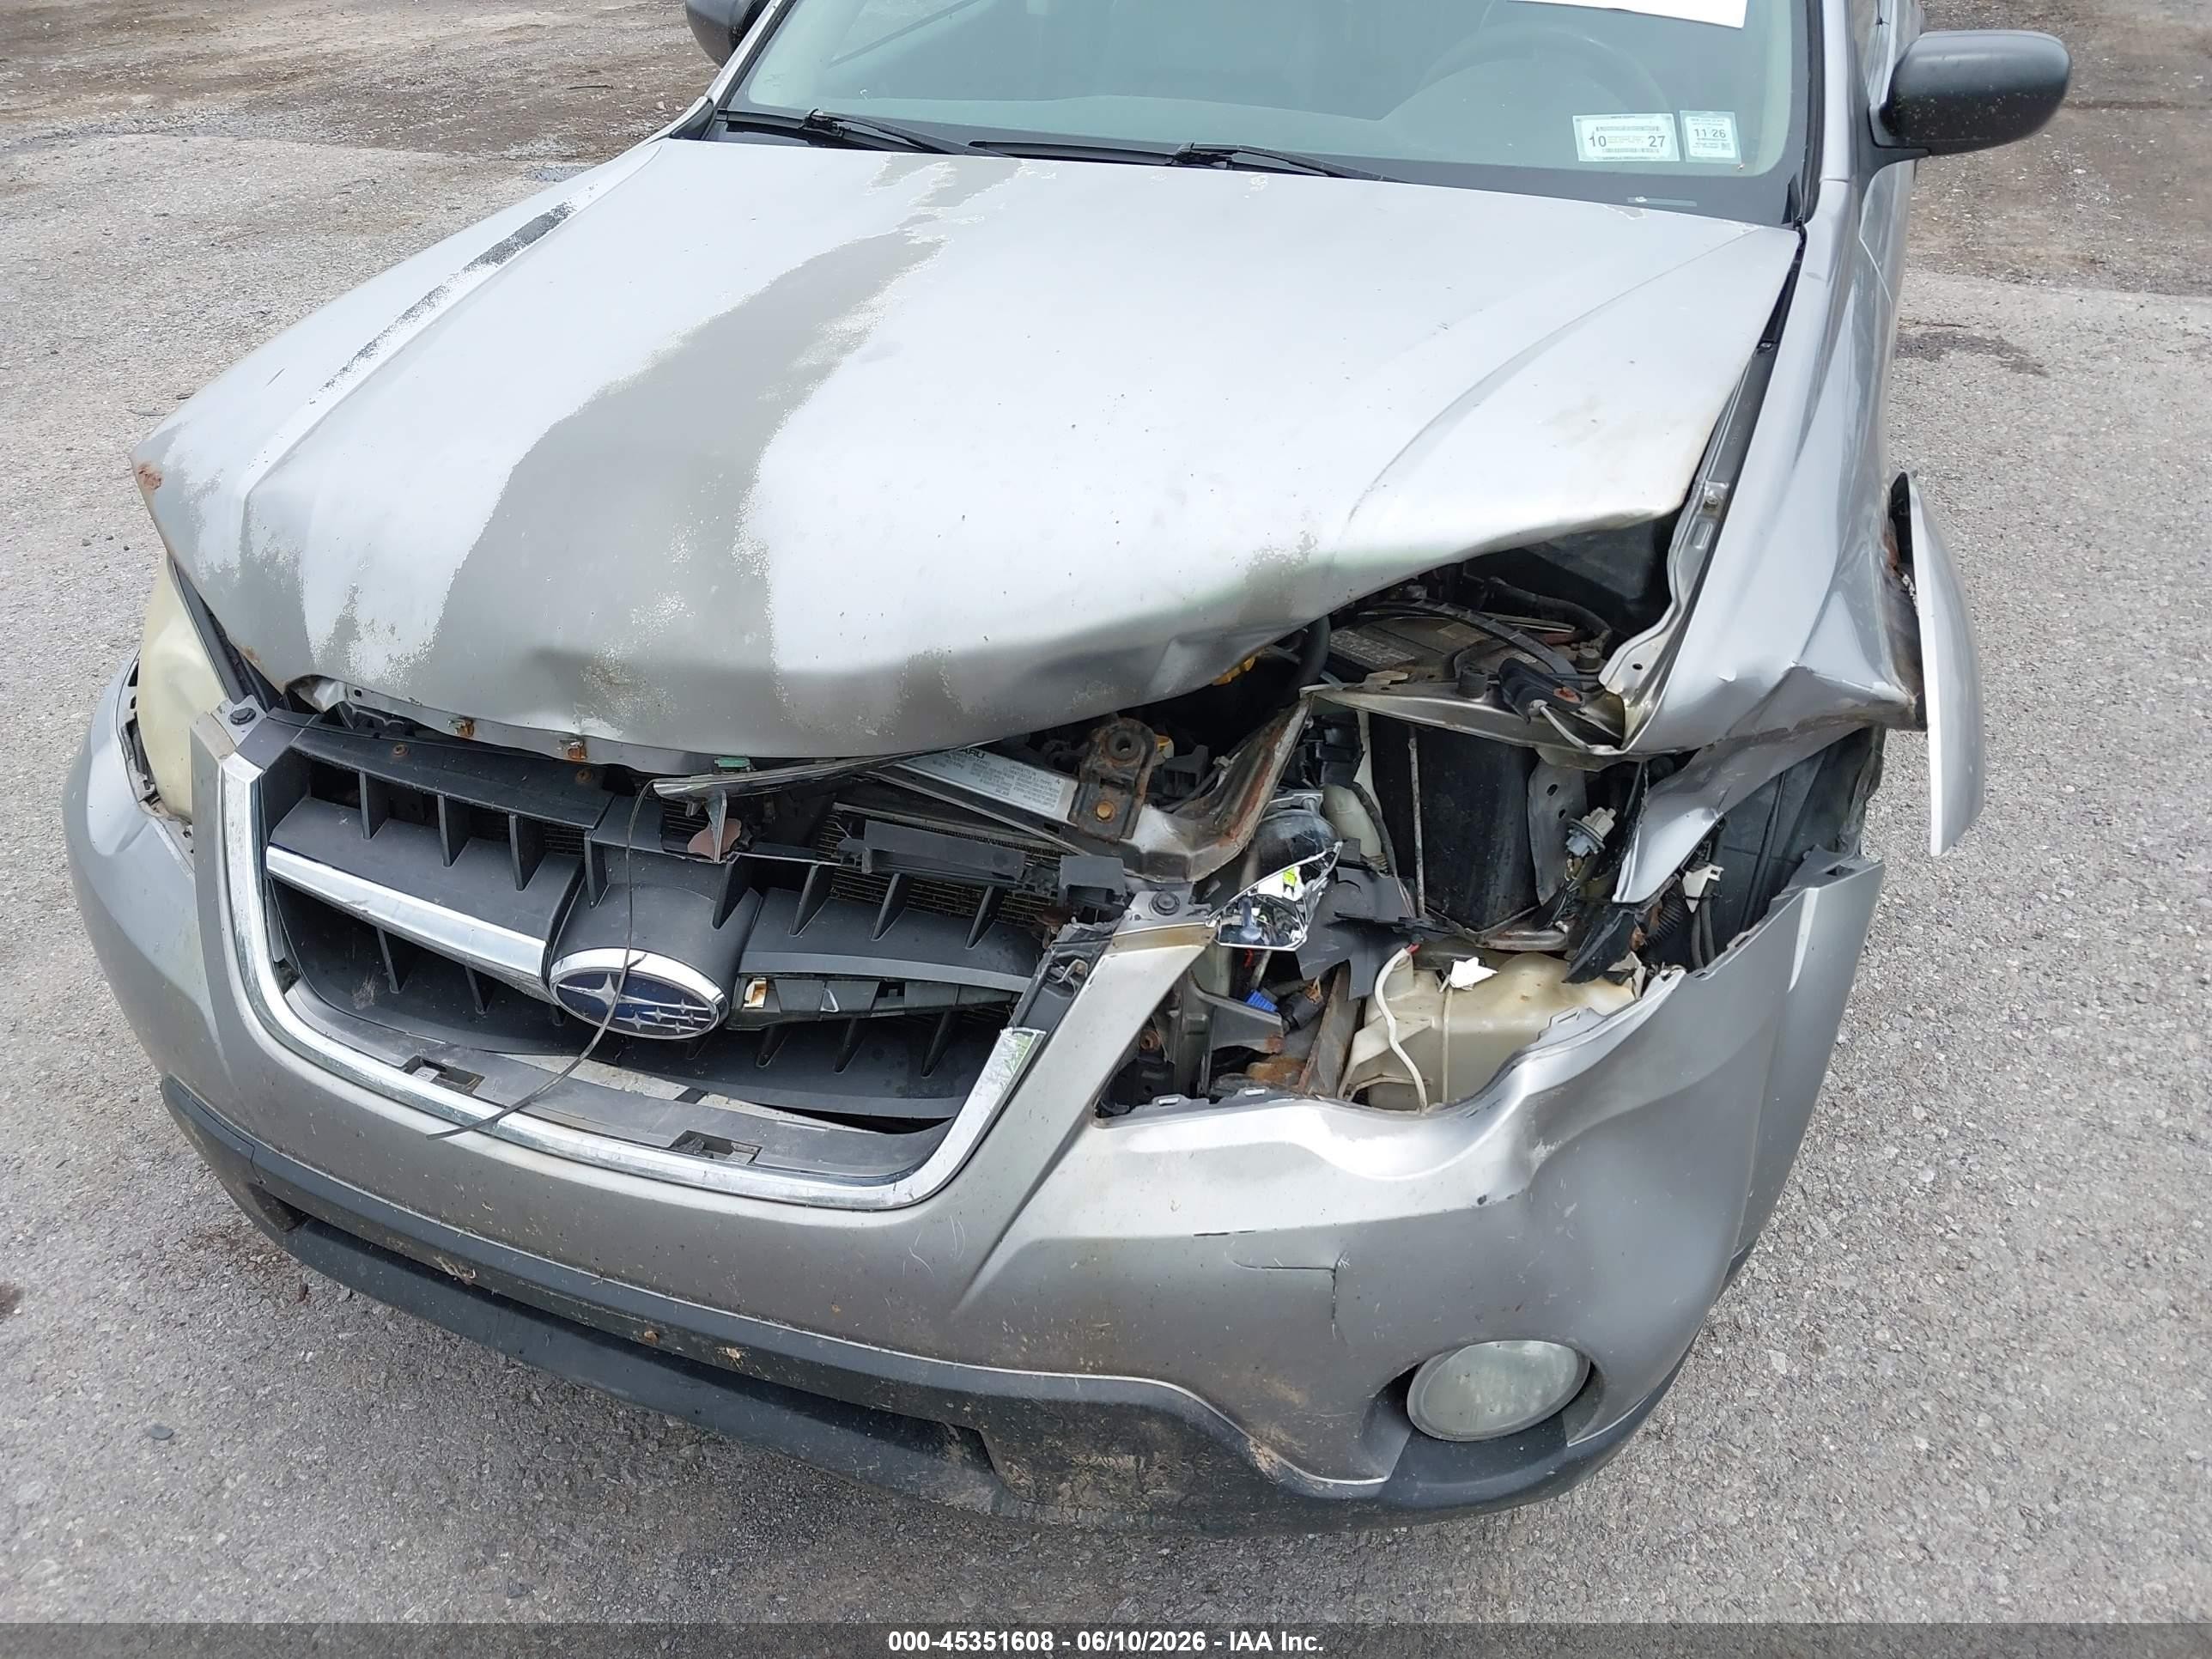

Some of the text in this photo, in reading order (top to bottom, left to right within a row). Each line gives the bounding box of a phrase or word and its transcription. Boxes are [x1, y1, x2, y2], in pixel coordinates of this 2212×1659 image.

[1693, 128, 1727, 139] 11 26
[1589, 135, 1607, 149] 10
[1648, 135, 1666, 149] 27
